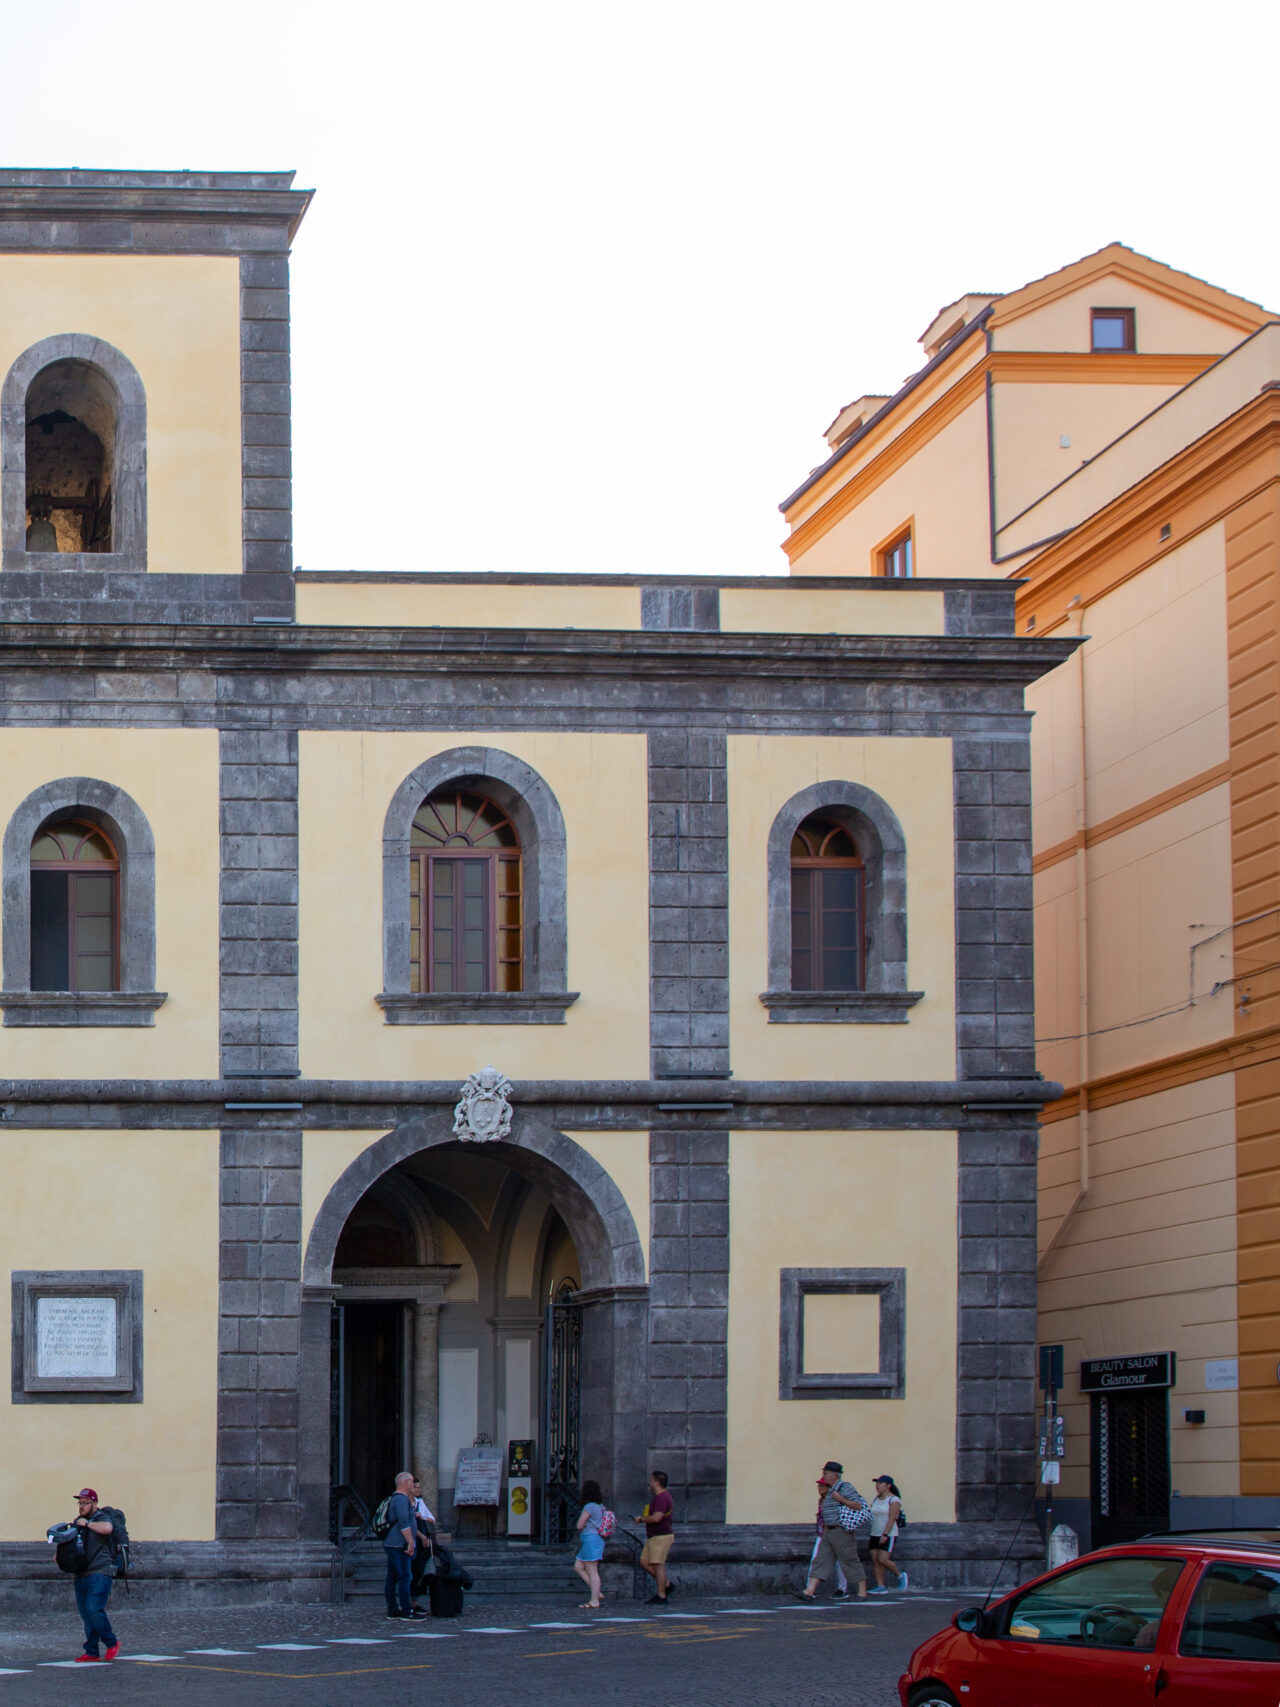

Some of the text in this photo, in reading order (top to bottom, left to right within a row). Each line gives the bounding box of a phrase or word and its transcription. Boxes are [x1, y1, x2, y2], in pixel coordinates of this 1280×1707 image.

[1091, 1357, 1159, 1373] BEAUTY SALON
[1101, 1373, 1147, 1386] Glamour
